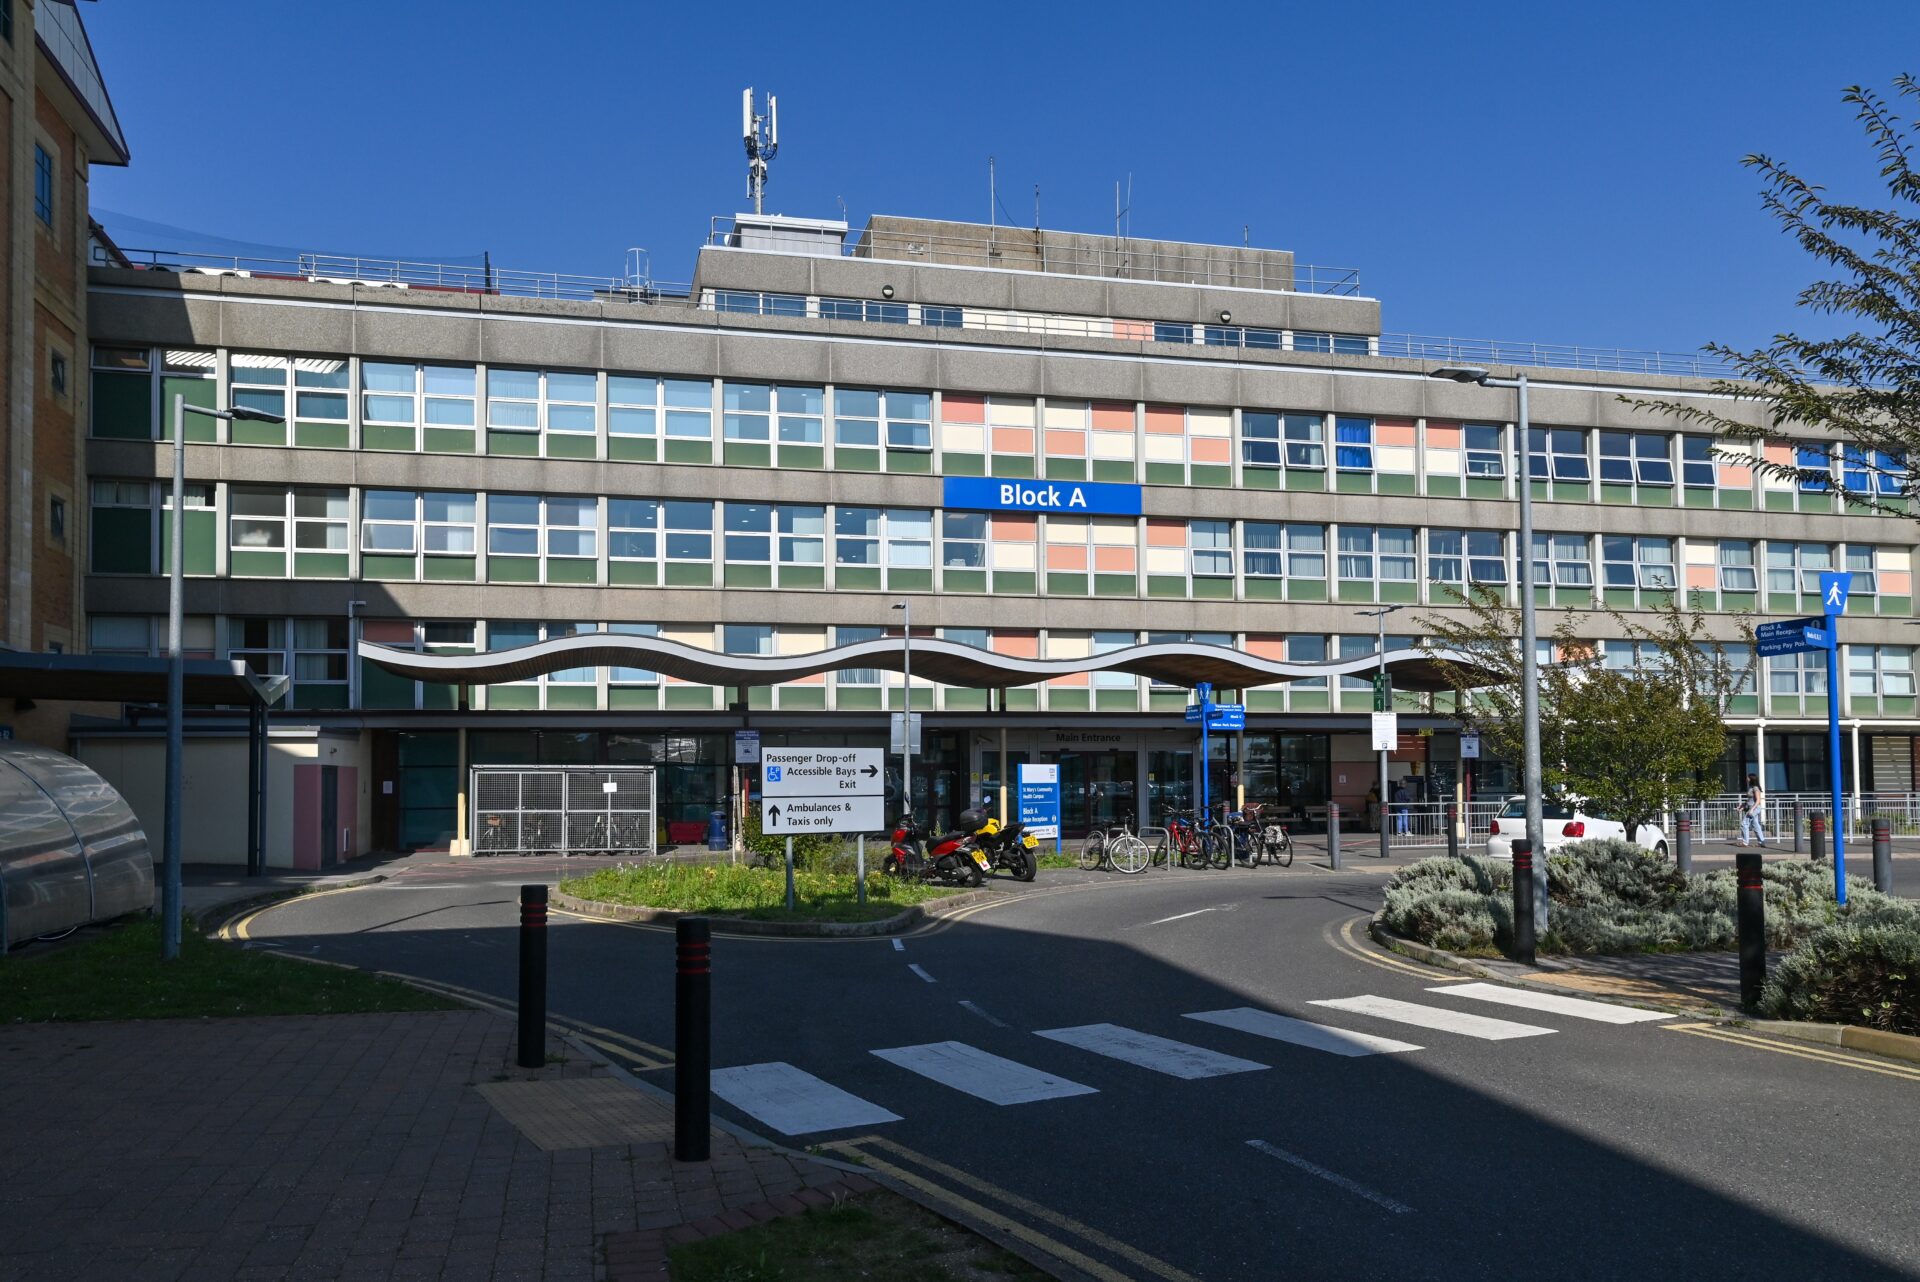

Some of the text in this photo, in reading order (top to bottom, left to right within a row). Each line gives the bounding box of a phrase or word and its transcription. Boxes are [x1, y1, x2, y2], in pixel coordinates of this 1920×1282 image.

[1000, 484, 1087, 507] Block A
[767, 754, 856, 764] Passenger Drop-off
[787, 767, 856, 777] Accessible Bays
[840, 780, 856, 788] Exit
[787, 803, 851, 812] Ambulances &
[787, 816, 833, 826] Taxis only
